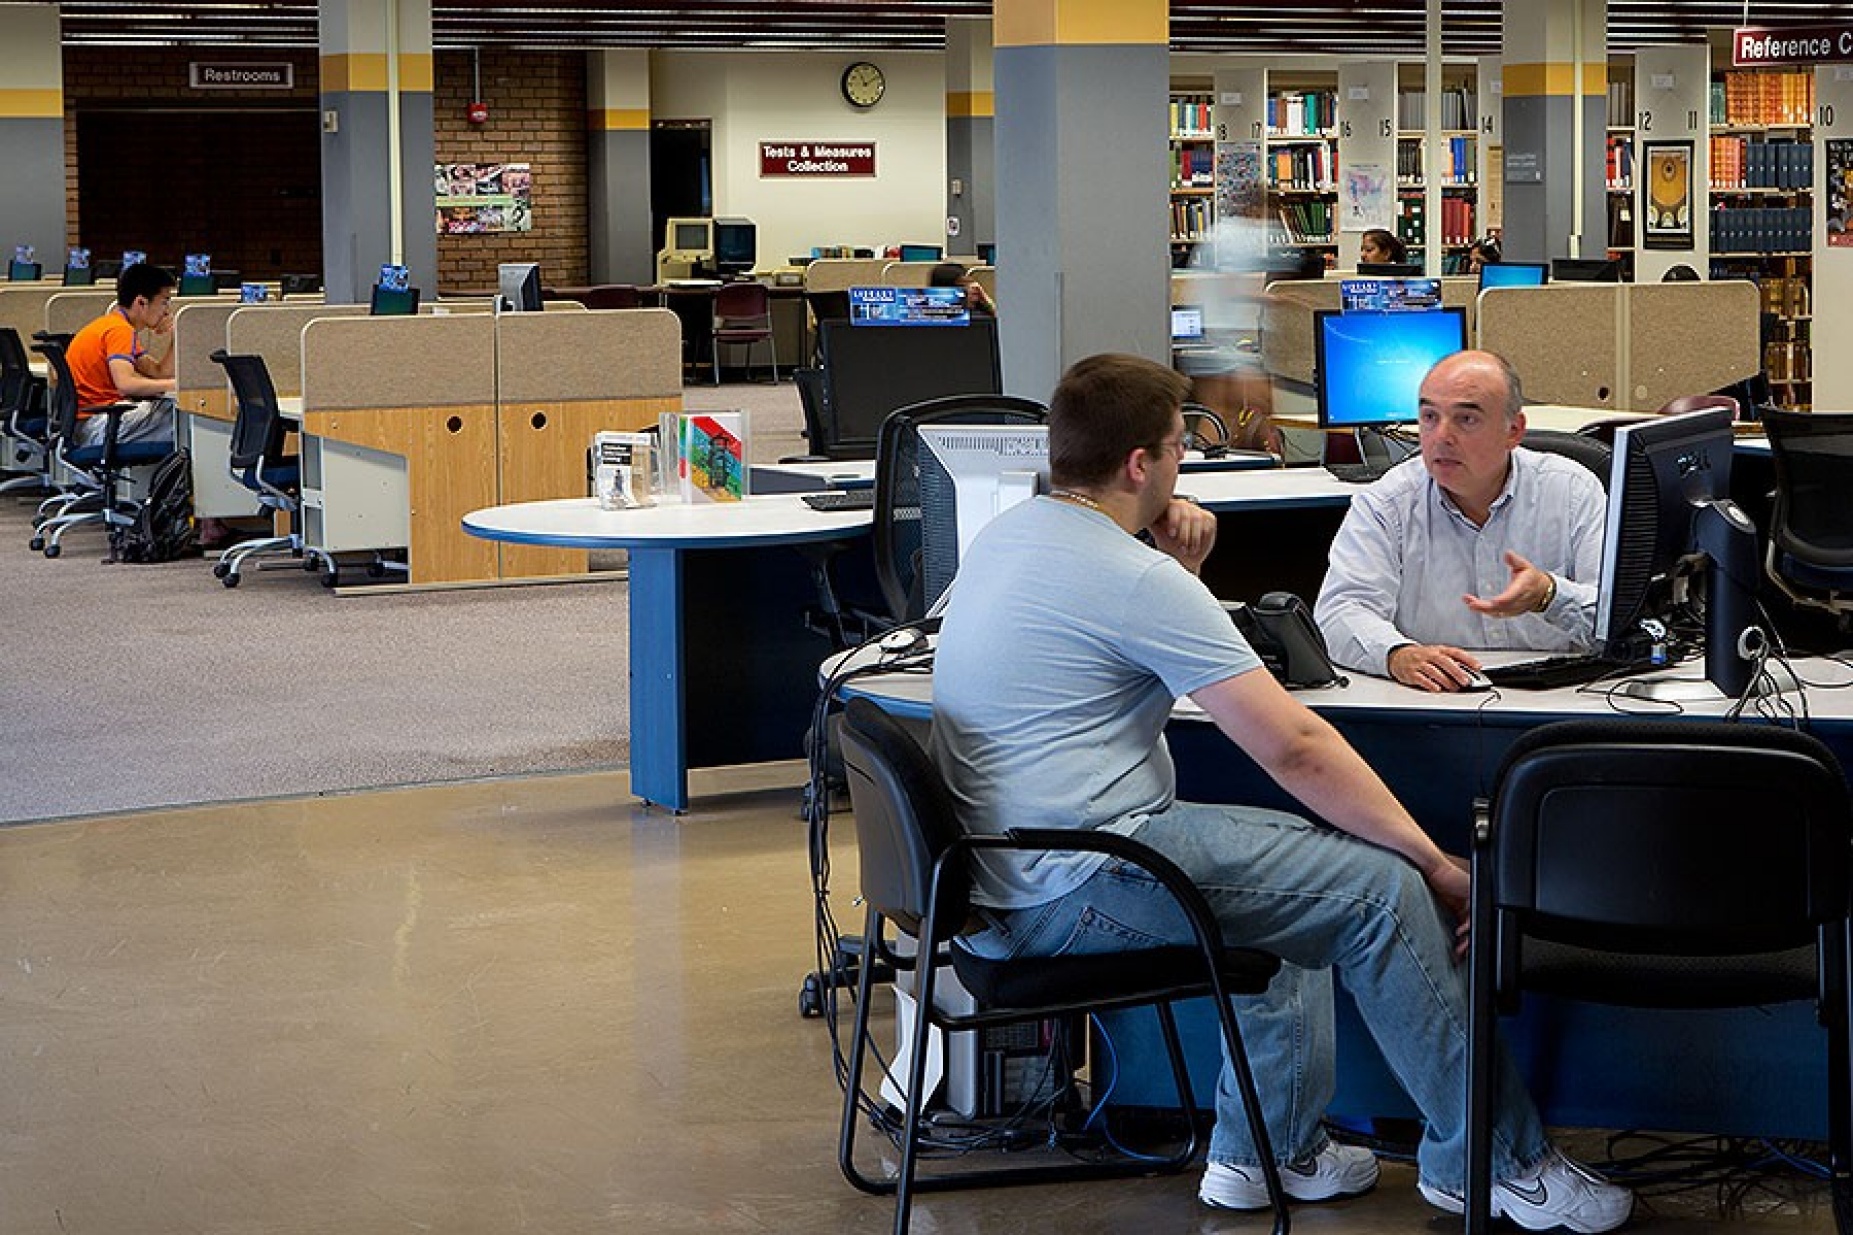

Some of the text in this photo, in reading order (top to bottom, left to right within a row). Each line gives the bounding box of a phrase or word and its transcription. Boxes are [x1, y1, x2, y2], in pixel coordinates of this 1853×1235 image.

[1741, 35, 1831, 58] Reference
[205, 68, 281, 81] Restrooms
[1482, 115, 1494, 134] 14
[1639, 111, 1652, 131] 12
[1687, 110, 1698, 130] 11
[1819, 105, 1834, 126] 10
[1379, 119, 1392, 136] 15
[764, 146, 872, 158] Tests & Measures
[787, 160, 849, 172] Collection
